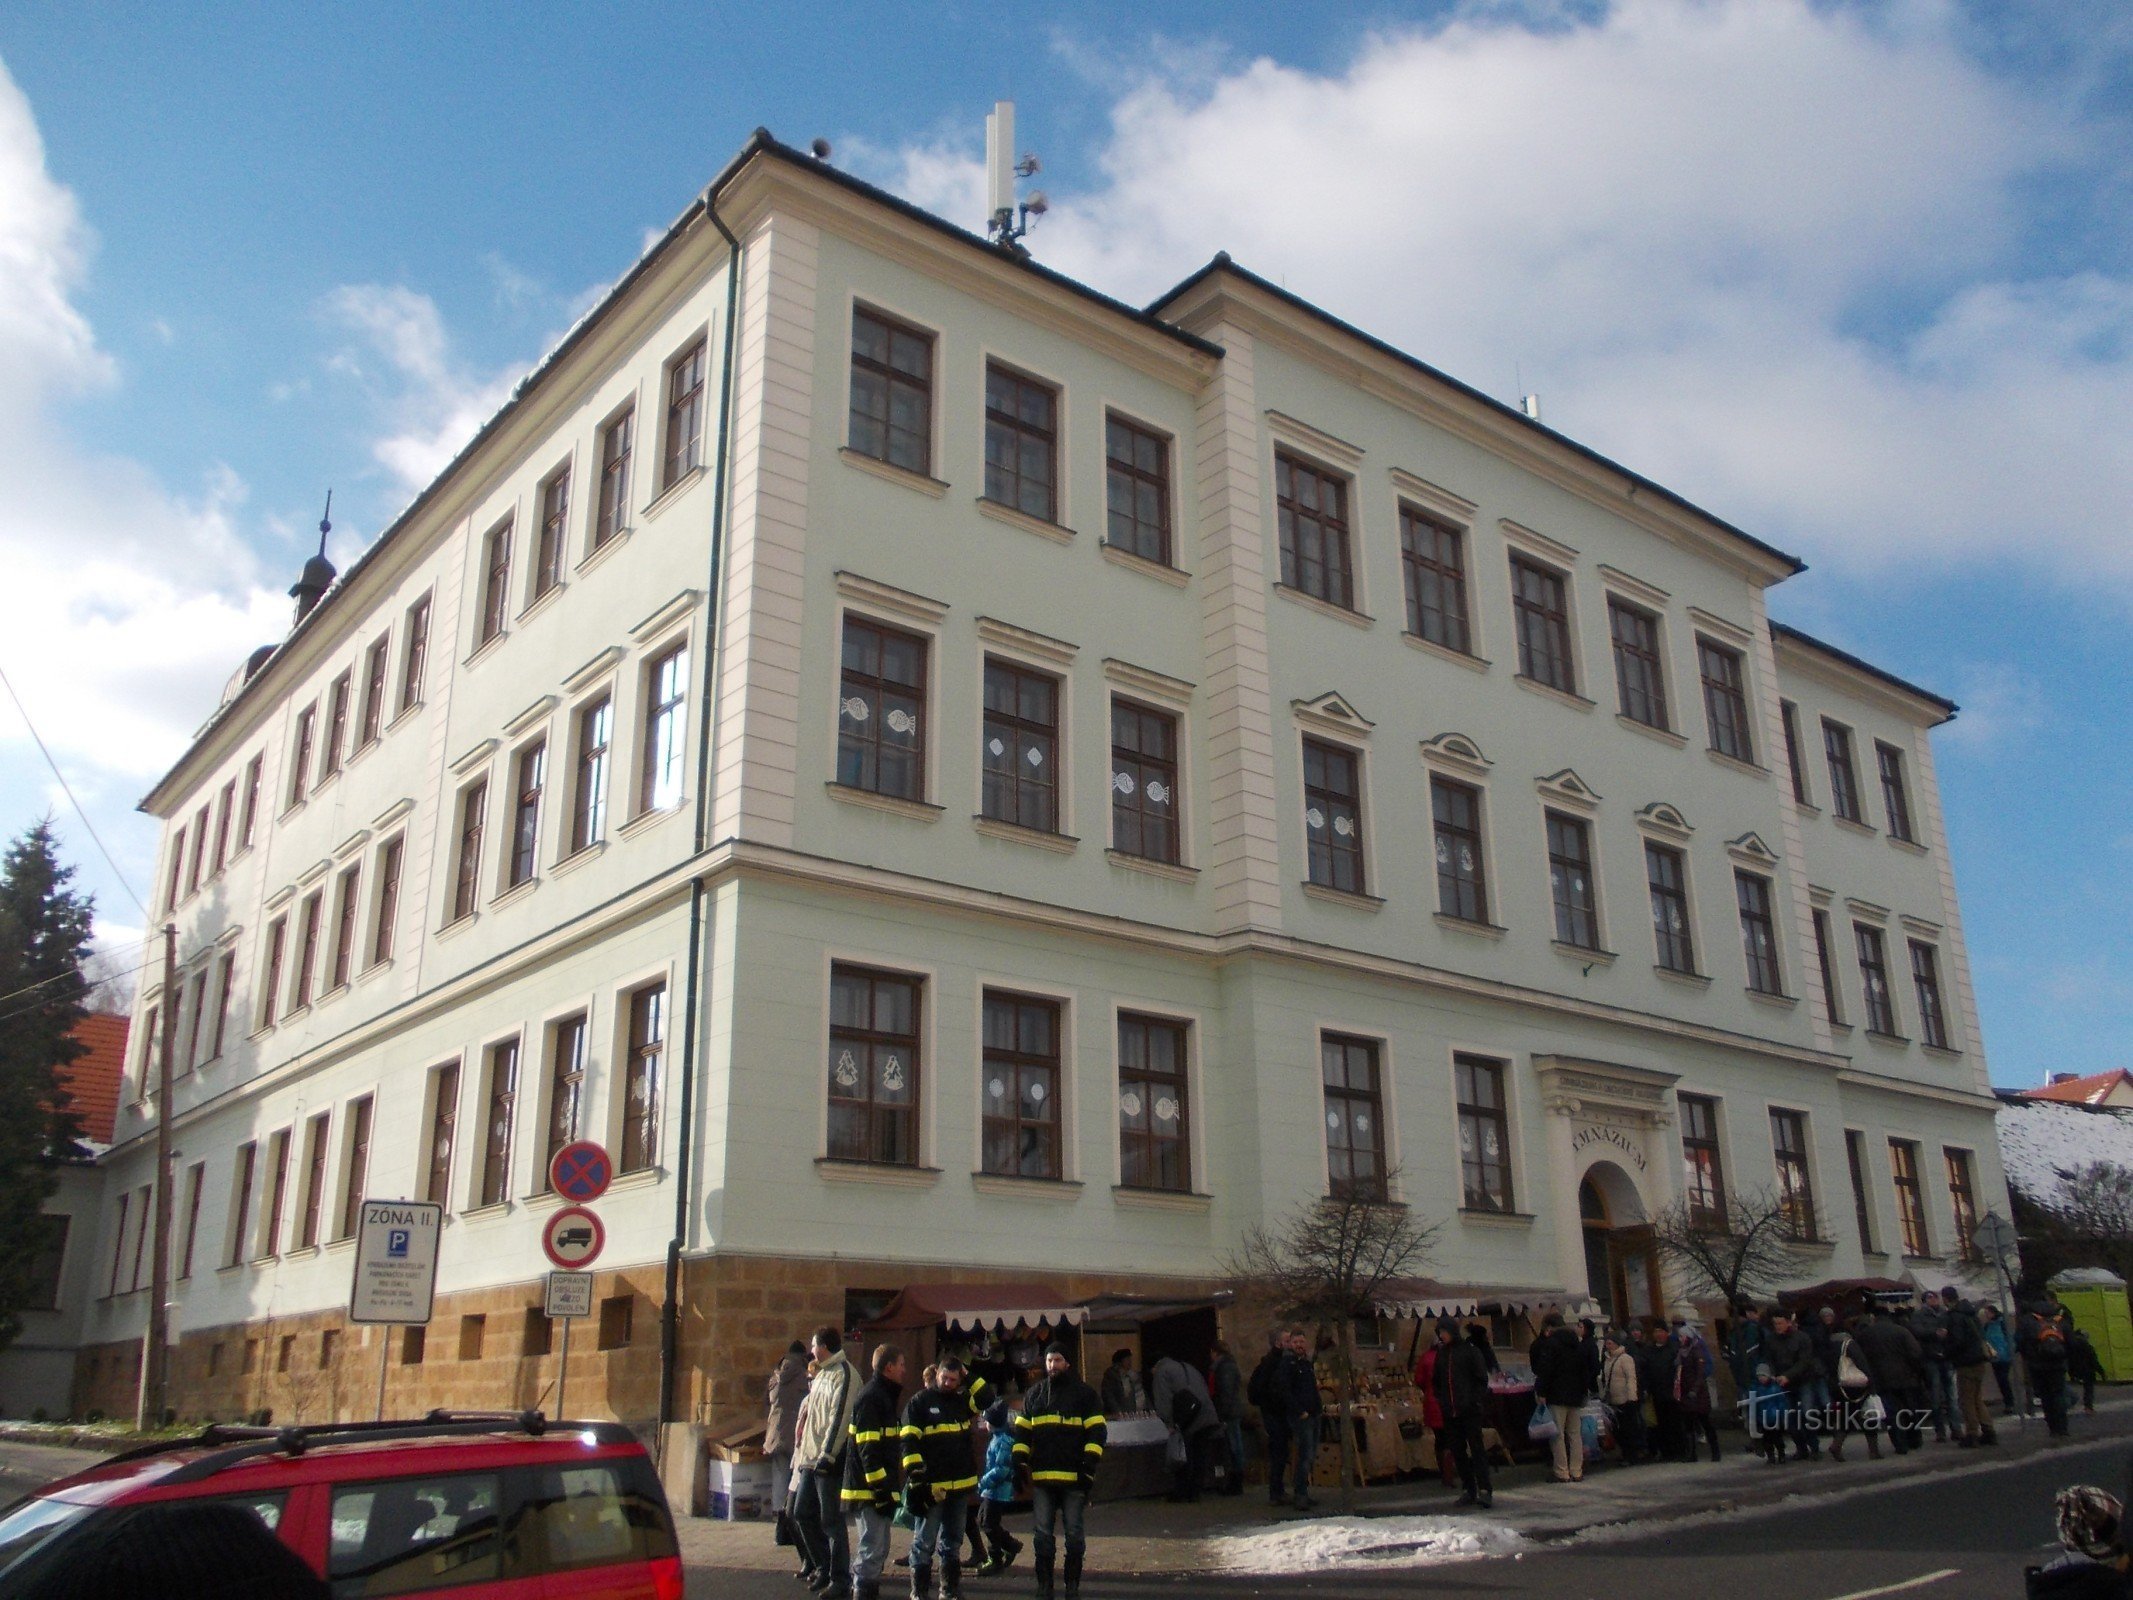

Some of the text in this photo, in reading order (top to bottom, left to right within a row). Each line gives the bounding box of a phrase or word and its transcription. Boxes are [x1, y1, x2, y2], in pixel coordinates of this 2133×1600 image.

[1572, 1125, 1647, 1173] YMNÁZIUM
[368, 1206, 434, 1227] ZÓNA II.
[391, 1231, 406, 1250] P
